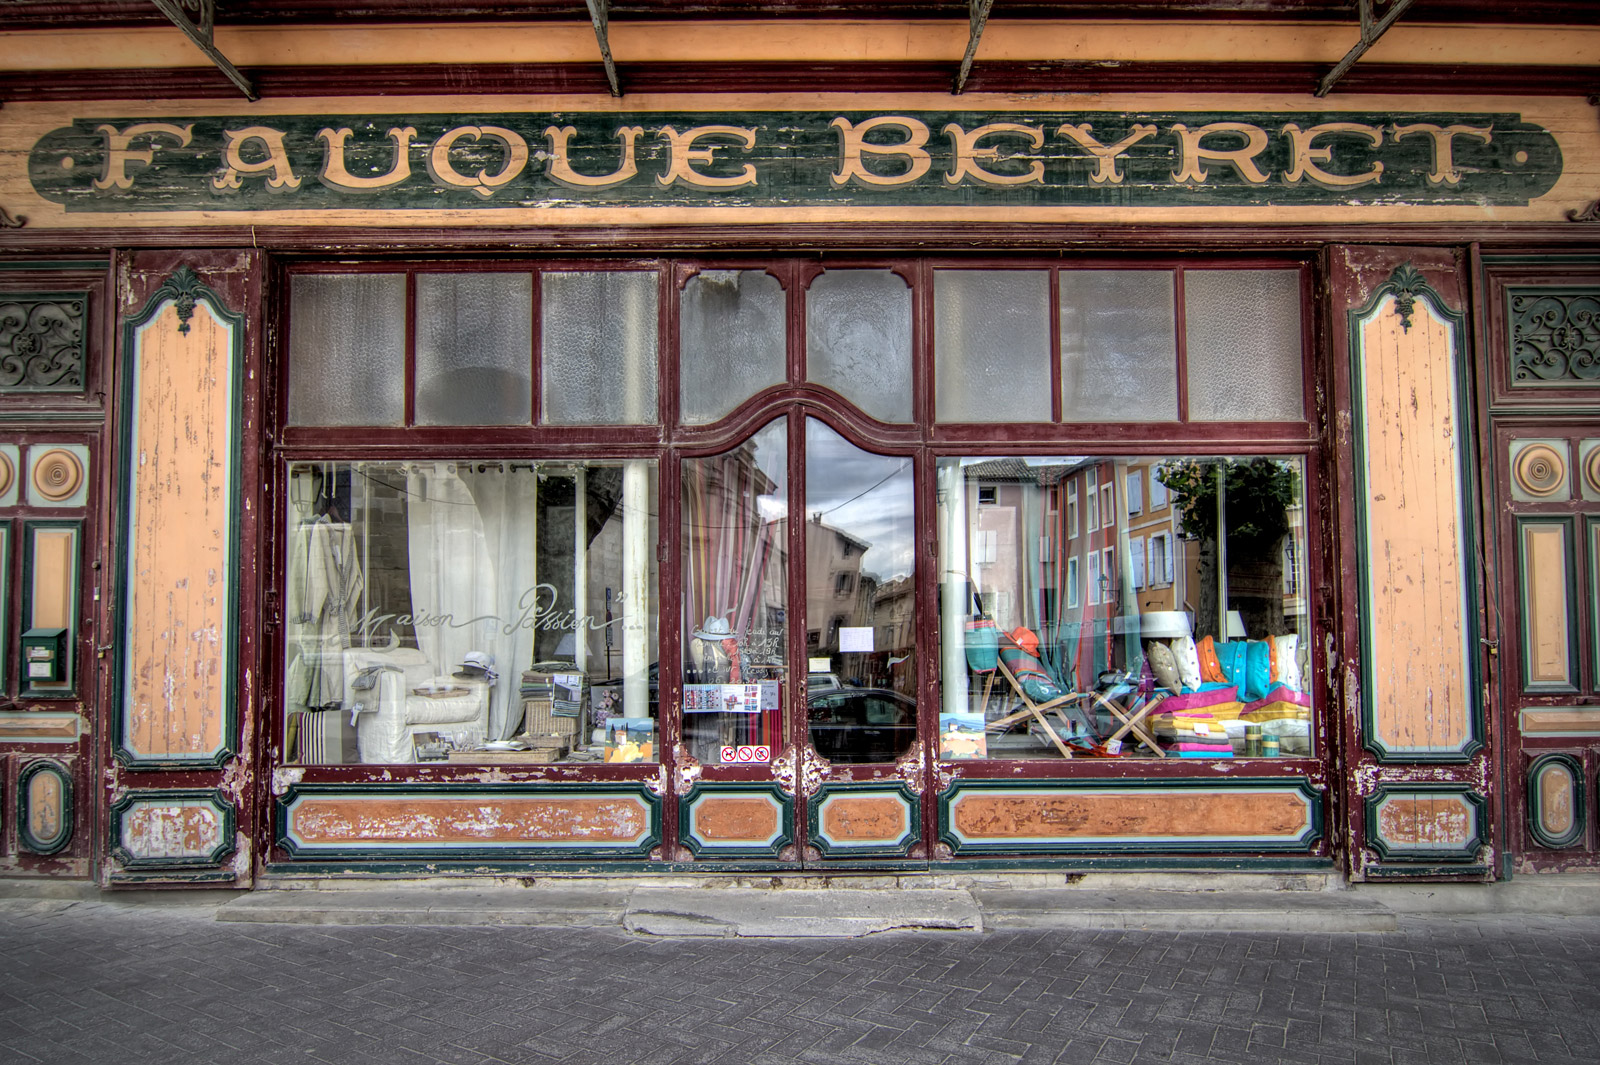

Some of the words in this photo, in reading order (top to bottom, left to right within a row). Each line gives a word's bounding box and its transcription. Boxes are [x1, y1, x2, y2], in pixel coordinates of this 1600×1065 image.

[91, 121, 759, 196] FAUQUE
[829, 115, 1495, 190] BEYRET
[354, 605, 466, 654] Maison
